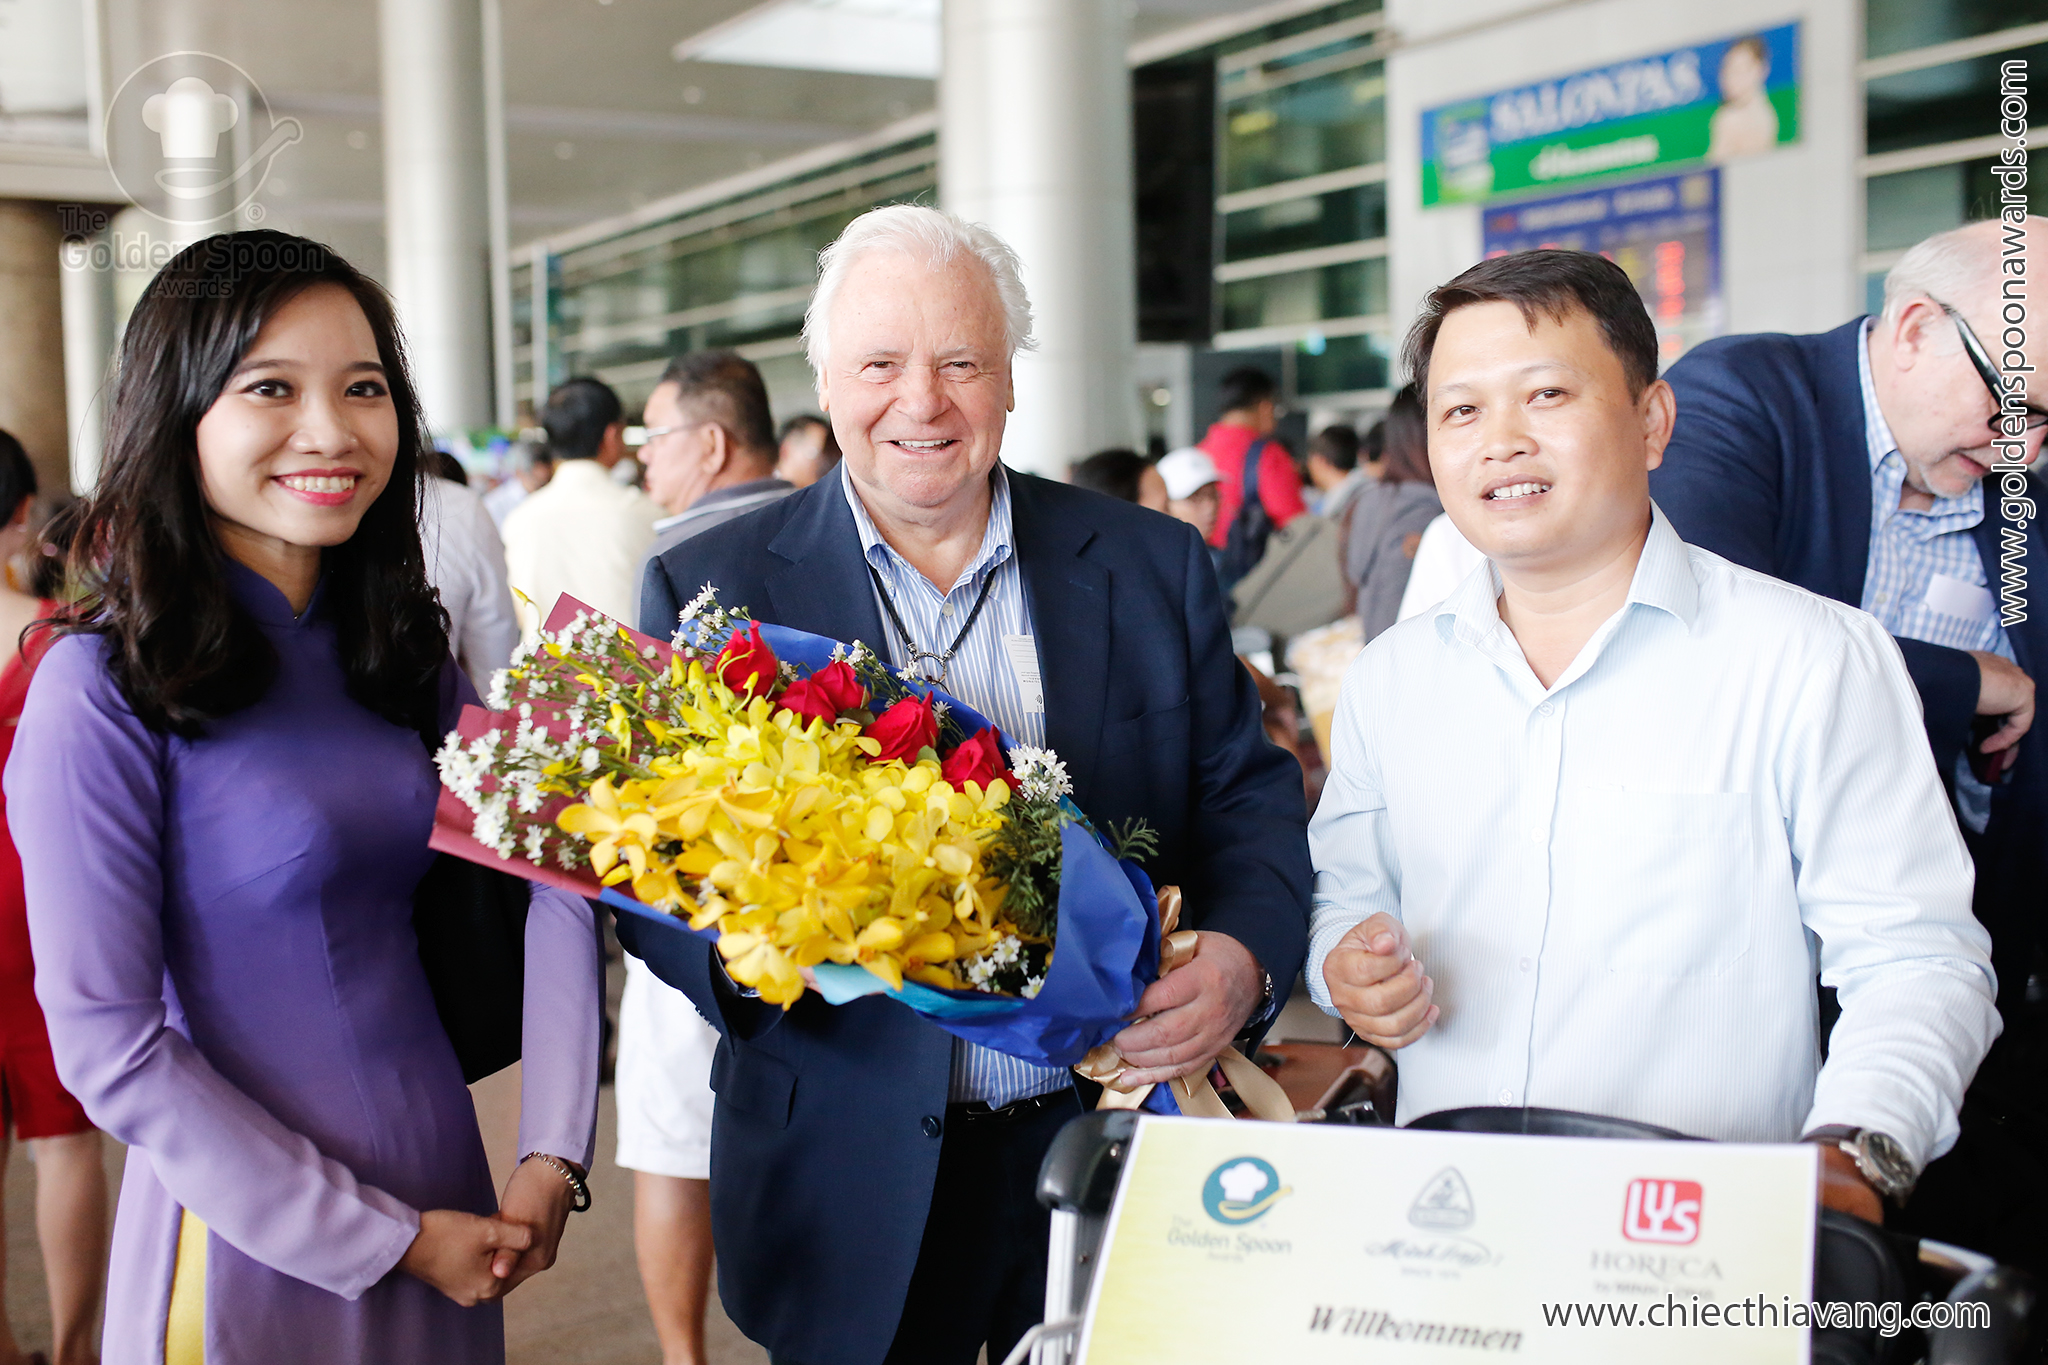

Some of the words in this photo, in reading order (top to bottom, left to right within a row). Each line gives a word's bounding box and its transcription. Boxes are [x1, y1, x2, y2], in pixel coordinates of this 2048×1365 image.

[1167, 1226, 1230, 1248] Golden
[1236, 1232, 1293, 1255] Spoon
[1590, 1249, 1723, 1281] HORECA
[1309, 1304, 1523, 1353] Willkommen
